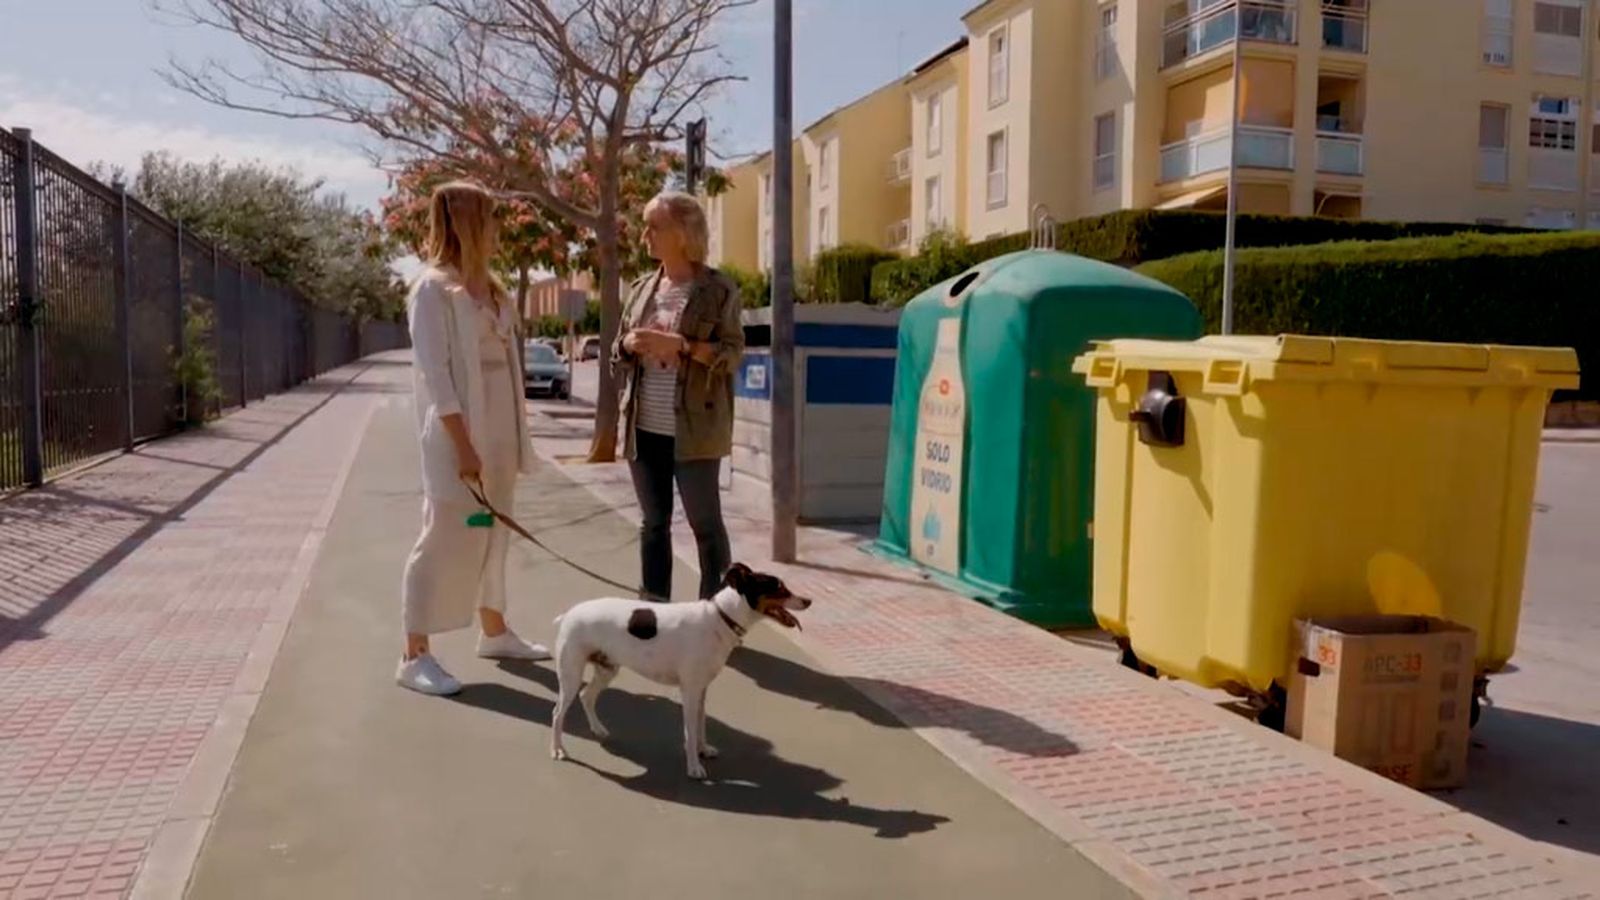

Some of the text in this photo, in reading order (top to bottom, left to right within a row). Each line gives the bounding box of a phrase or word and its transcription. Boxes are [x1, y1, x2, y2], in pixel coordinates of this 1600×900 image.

[926, 440, 950, 463] SOLO
[921, 467, 953, 494] VIDRIO
[1319, 645, 1336, 665] 33
[1363, 653, 1422, 672] APC-33
